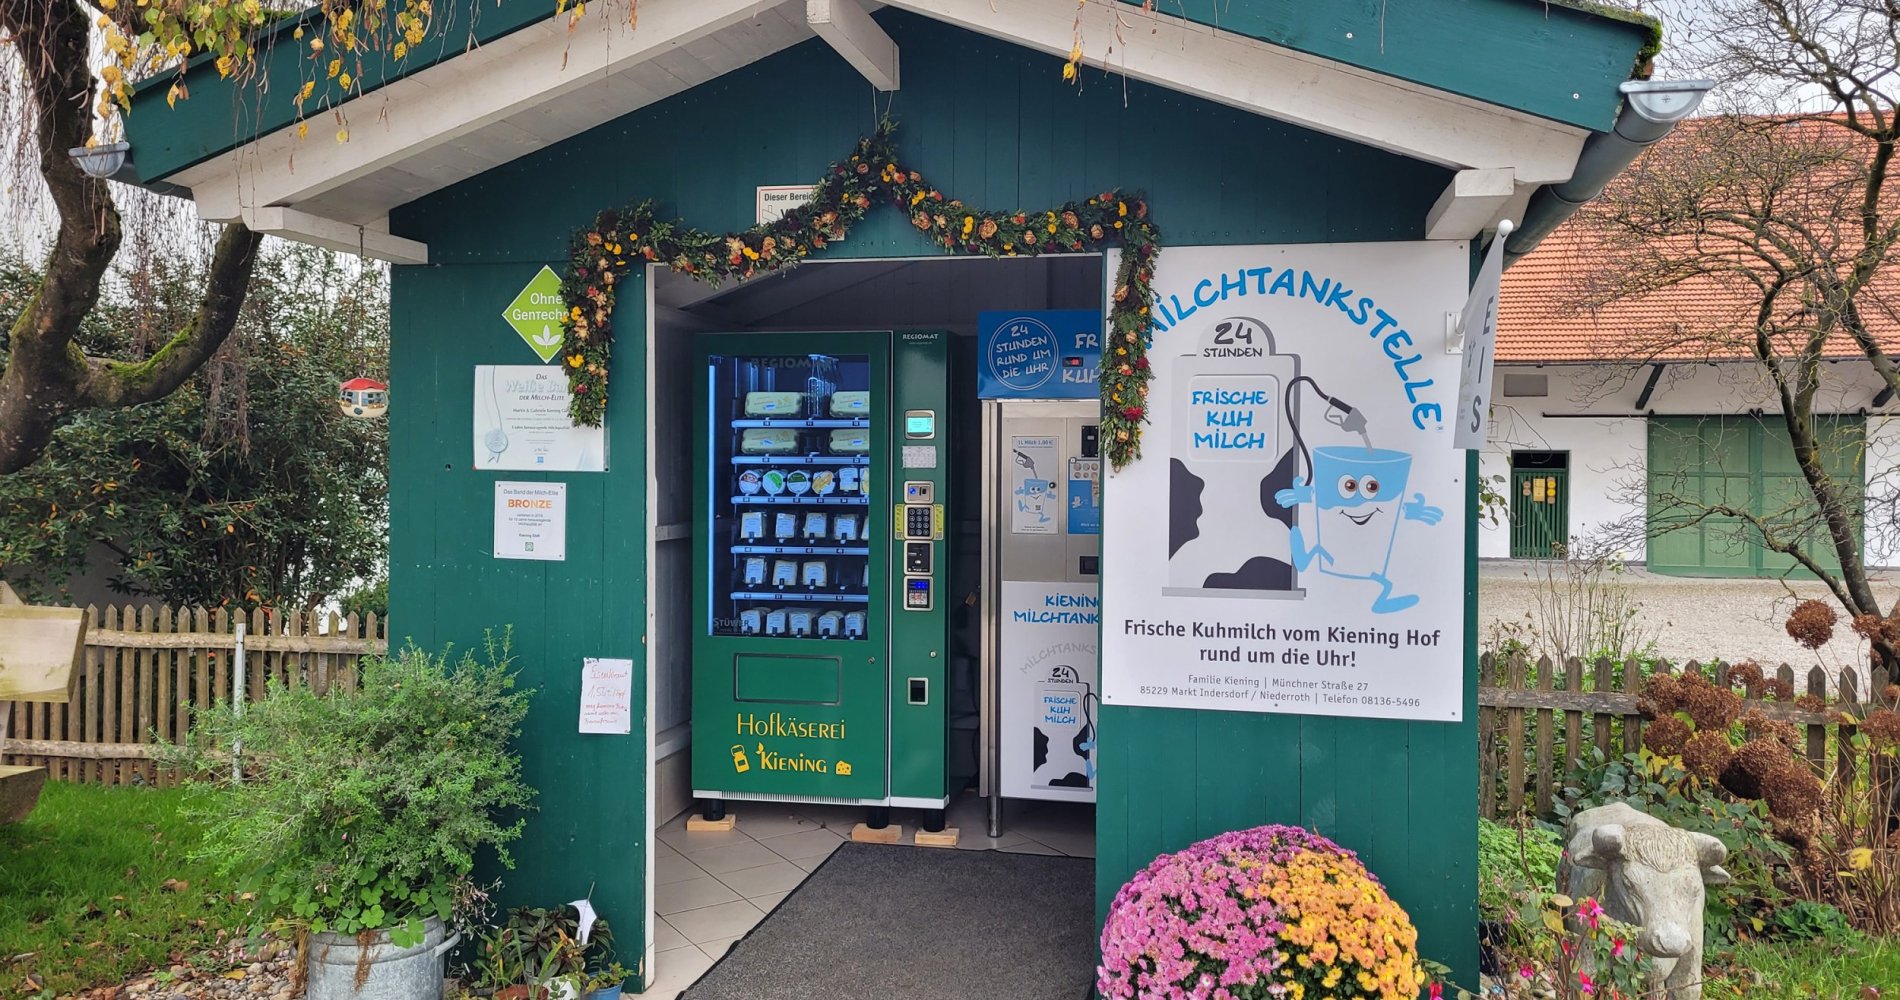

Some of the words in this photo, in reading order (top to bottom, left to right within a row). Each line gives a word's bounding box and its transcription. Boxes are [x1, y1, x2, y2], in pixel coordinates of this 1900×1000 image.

[764, 193, 787, 201] Dieser
[530, 292, 563, 305] Ohne
[1011, 324, 1029, 337] 24
[1214, 321, 1252, 345] 24
[996, 335, 1048, 354] STUNDEN
[1203, 347, 1263, 358] STUNDEN
[996, 353, 1028, 367] RUND
[1032, 349, 1051, 360] UM
[1471, 296, 1494, 433] EIS
[1002, 367, 1021, 379] DIE
[1025, 362, 1049, 375] UHR
[1192, 387, 1269, 406] FRISCHE
[1206, 410, 1253, 428] KUH
[1194, 430, 1265, 450] MILCH
[508, 499, 552, 509] BRONZE
[1124, 619, 1186, 638] Frische
[1192, 621, 1276, 642] Kuhmilch
[1282, 628, 1320, 642] vom
[1327, 626, 1399, 649] Kiening
[1406, 629, 1441, 647] Hof
[1200, 647, 1240, 663] rund
[1247, 652, 1276, 664] um
[1281, 648, 1310, 666] die
[1316, 650, 1357, 668] Uhr!
[1052, 667, 1070, 678] 24
[1188, 674, 1221, 686] Familie
[1224, 676, 1260, 688] Kiening
[1272, 678, 1319, 689] Münchner
[1321, 680, 1354, 691] Straße
[1357, 682, 1369, 692] 27
[1044, 695, 1078, 705] FRISCHE
[1140, 685, 1168, 696] 85229
[1171, 686, 1197, 697] Markt
[1200, 687, 1249, 699] Indersdorf
[1260, 691, 1310, 702] Niederroth
[1322, 693, 1358, 704] Telefon
[1361, 695, 1421, 708] 08136-5496
[1050, 705, 1071, 714] KUH
[1044, 714, 1076, 725] MILCH
[760, 751, 827, 773] Kiening
